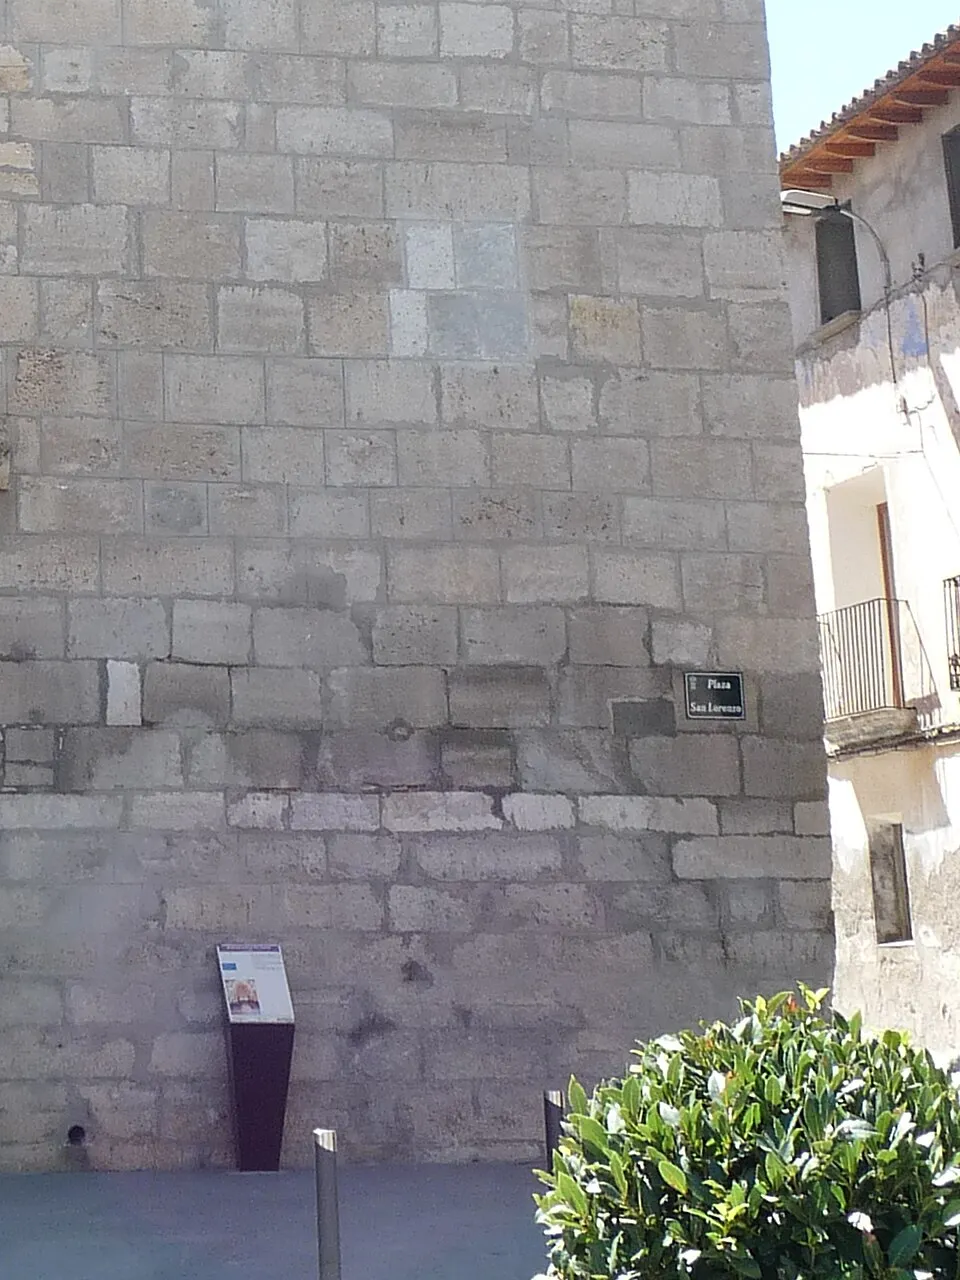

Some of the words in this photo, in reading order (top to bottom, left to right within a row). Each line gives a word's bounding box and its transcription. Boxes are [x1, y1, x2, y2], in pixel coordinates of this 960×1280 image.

[707, 678, 731, 690] Plaza
[690, 701, 707, 713] San
[708, 701, 742, 713] Lorenzo
